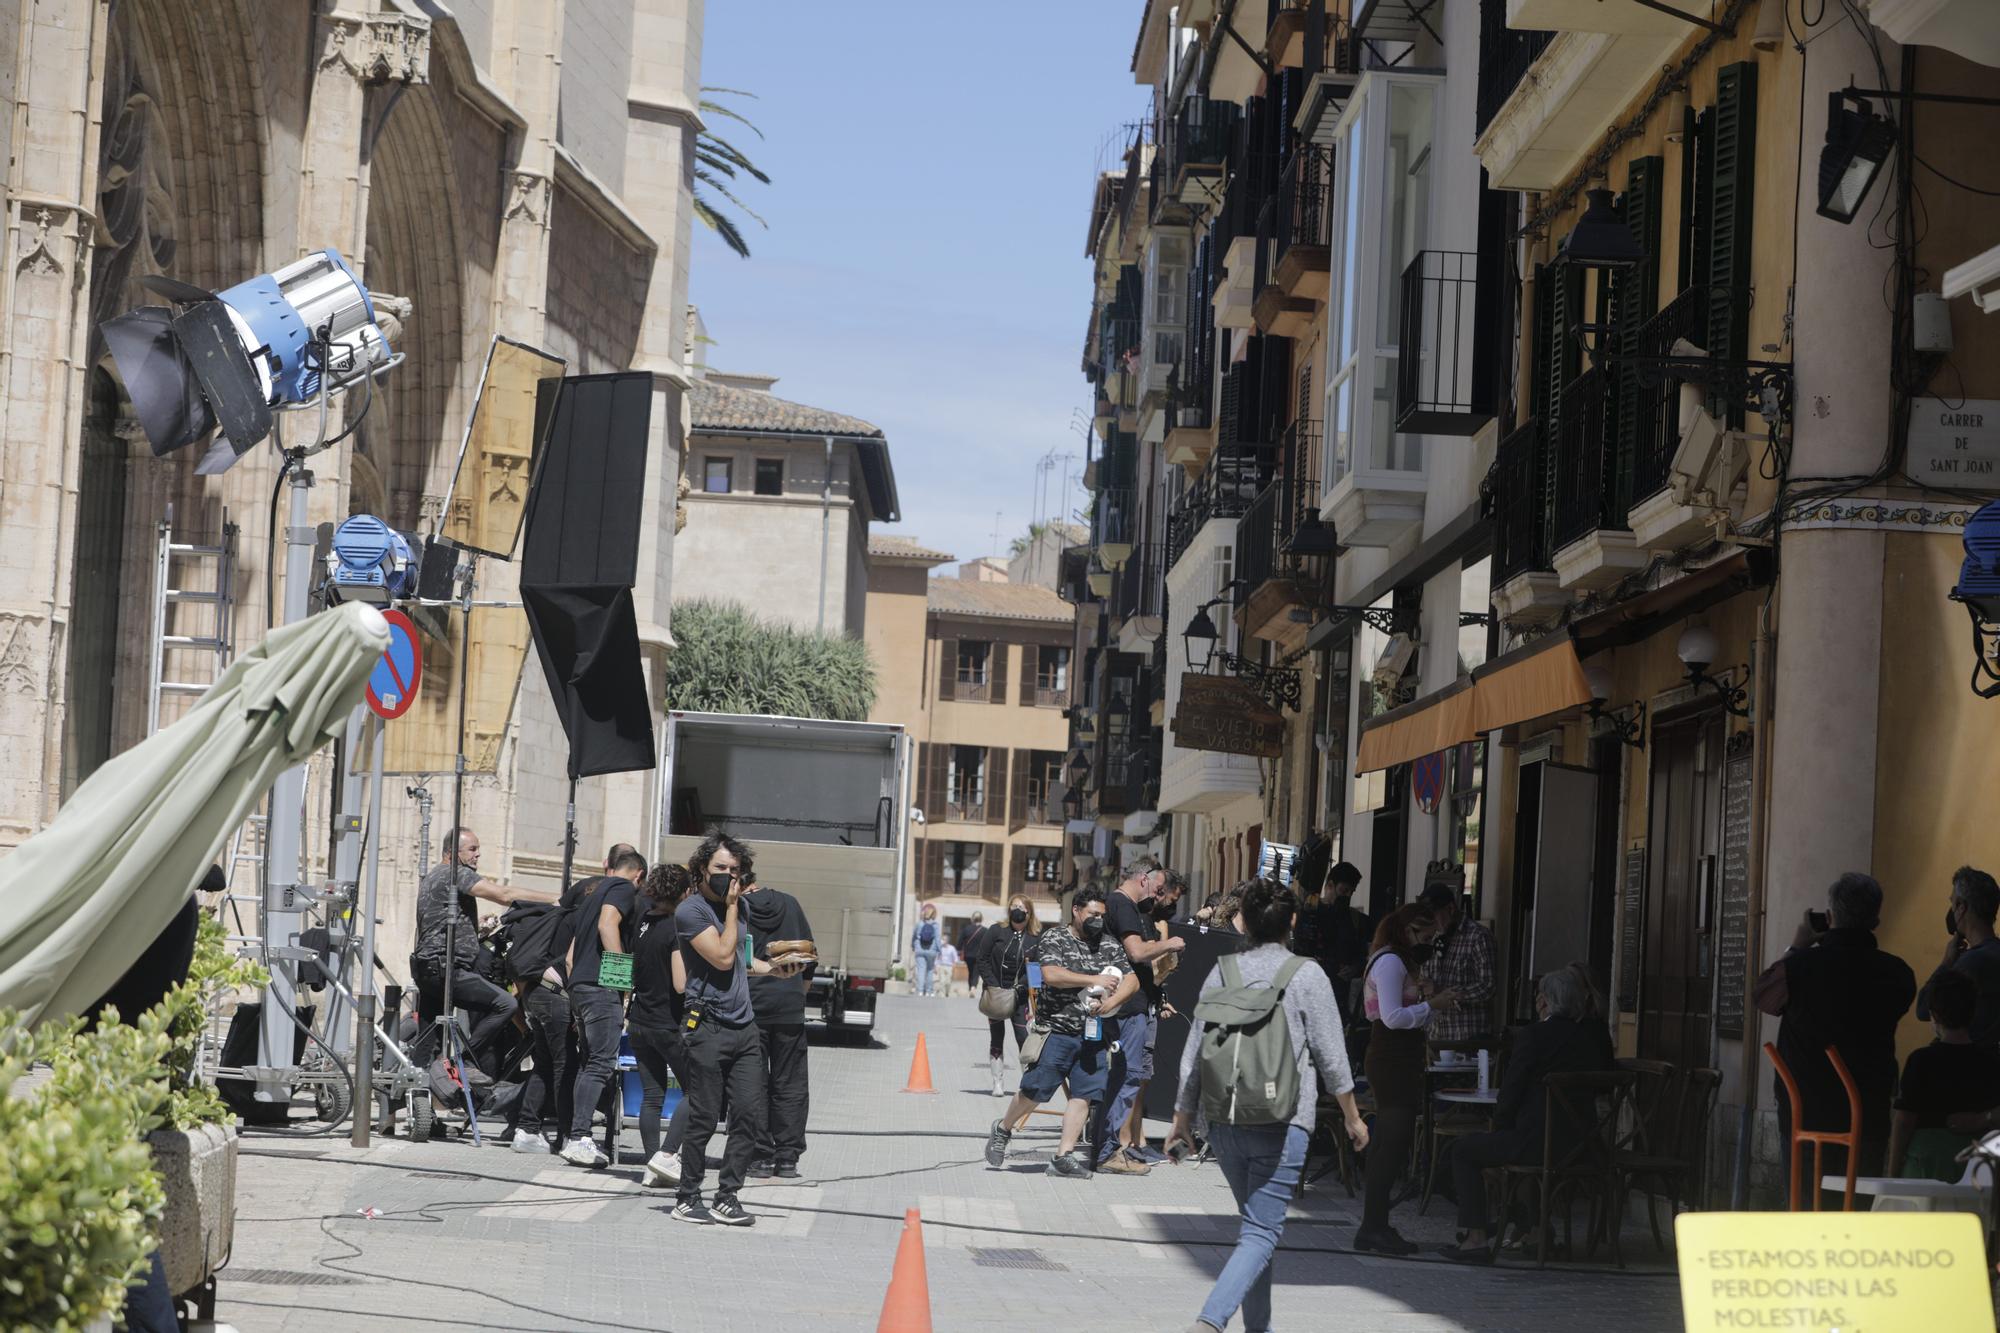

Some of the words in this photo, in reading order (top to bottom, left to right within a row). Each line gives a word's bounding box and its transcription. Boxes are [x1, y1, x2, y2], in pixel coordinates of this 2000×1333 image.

[1940, 413, 1983, 428] CARRER
[1954, 437, 1969, 450] DE
[1929, 458, 1960, 473] SANT
[1963, 460, 1993, 474] JOAN
[1192, 716, 1208, 730] EL
[1215, 719, 1264, 737] VIEJO
[1825, 1249, 1955, 1270] RODANDO
[1711, 1279, 1848, 1299] PERDONEN
[1855, 1277, 1898, 1298] LAS
